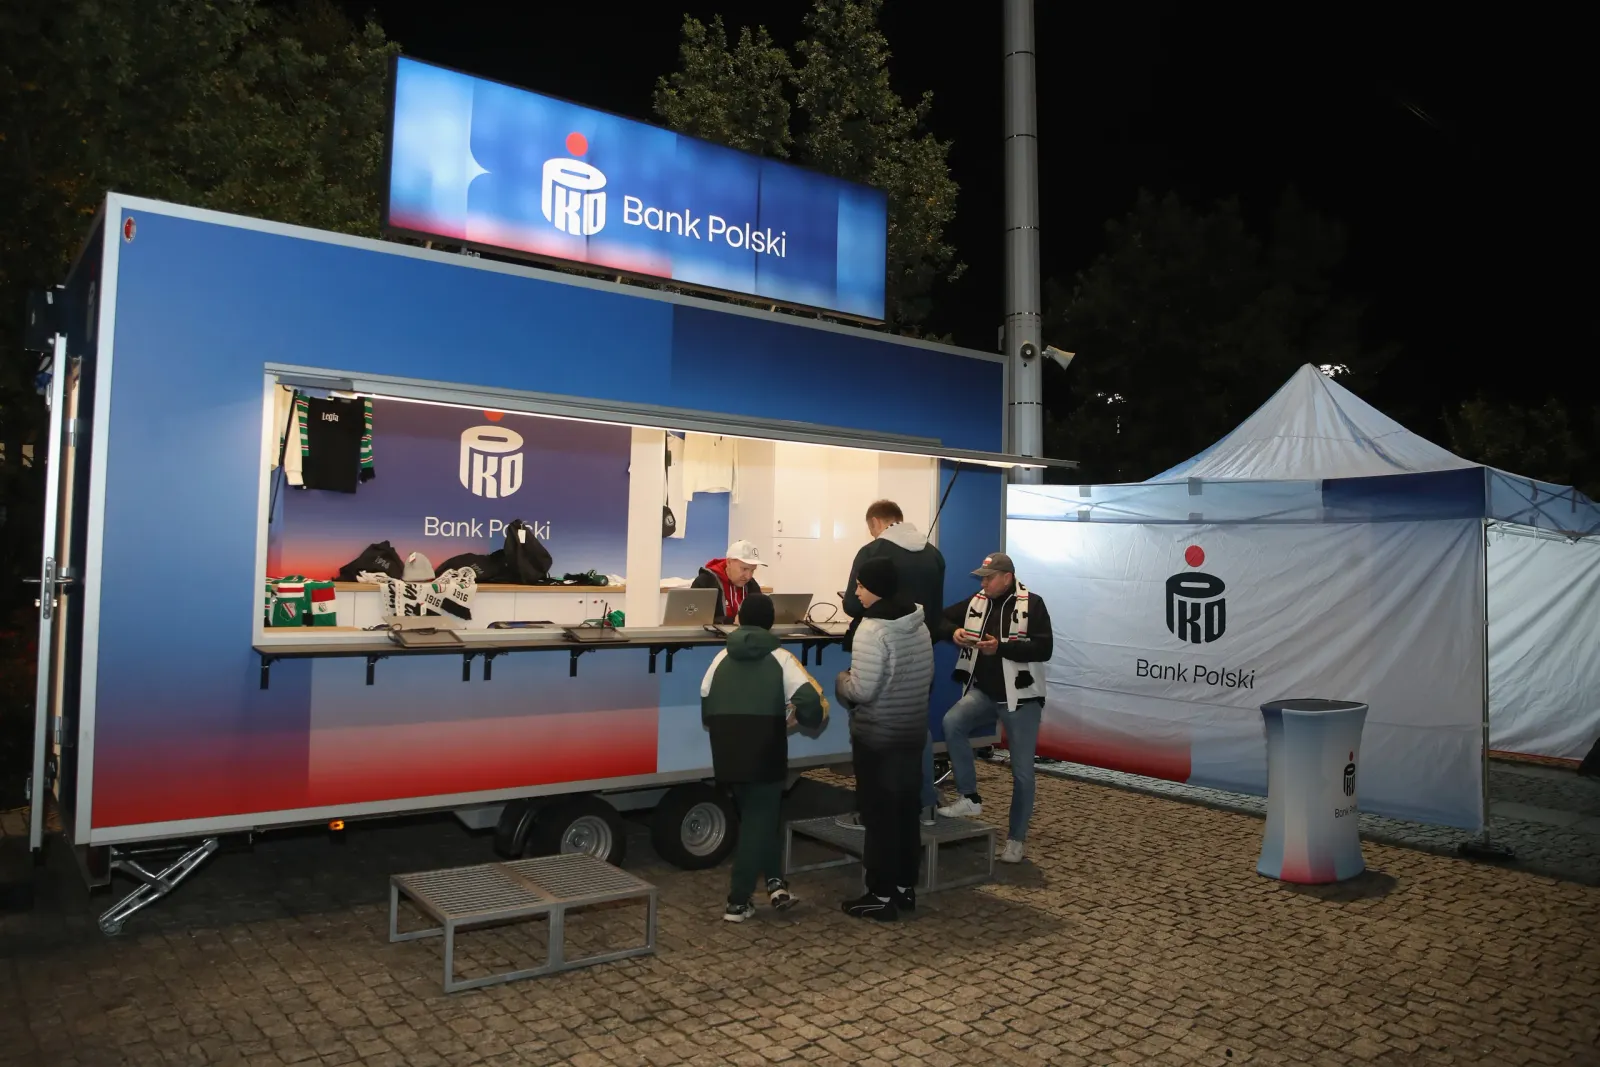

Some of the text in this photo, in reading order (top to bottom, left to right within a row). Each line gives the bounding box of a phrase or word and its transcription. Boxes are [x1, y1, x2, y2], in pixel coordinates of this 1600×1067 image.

[541, 157, 607, 236] PKO
[623, 195, 787, 258] Bank Polski
[459, 425, 524, 499] PKO
[424, 516, 551, 540] Bank Pki
[424, 593, 441, 608] 1916
[452, 588, 469, 603] 1916
[1165, 571, 1227, 644] PKO
[1136, 658, 1256, 690] Bank Polski
